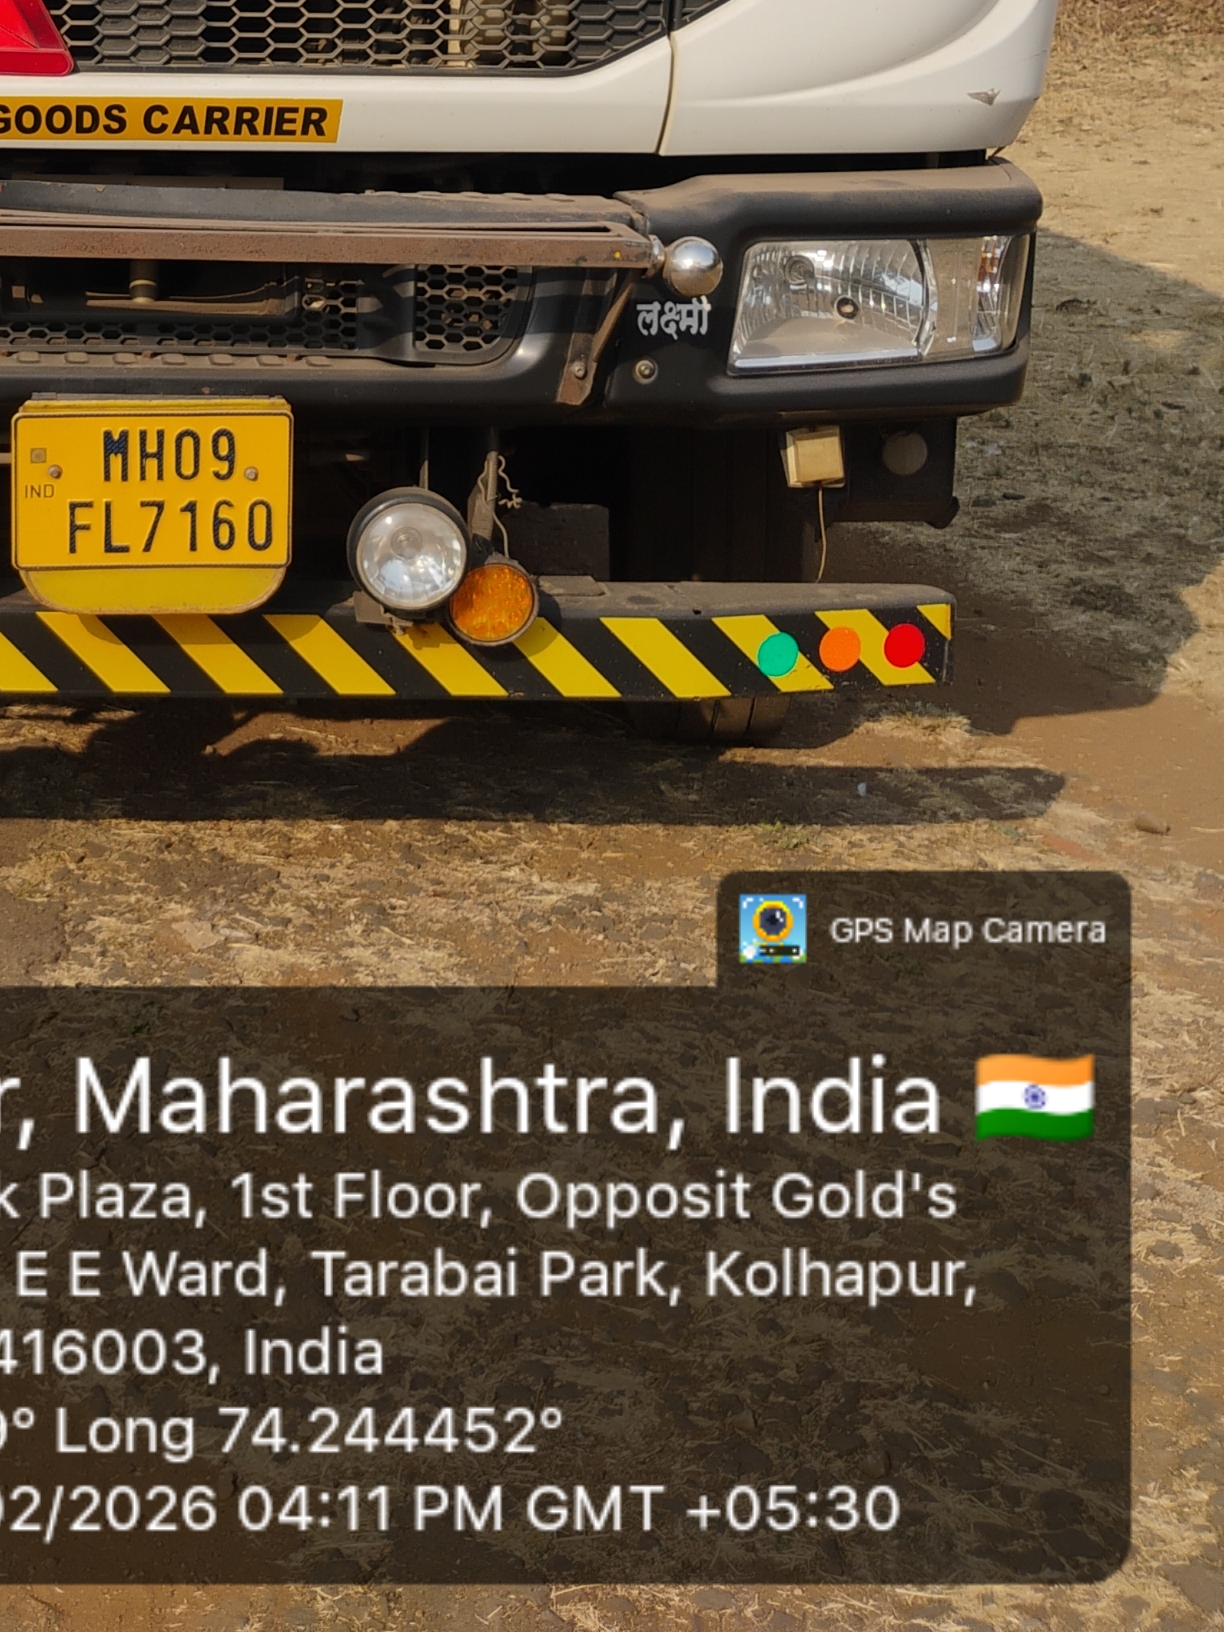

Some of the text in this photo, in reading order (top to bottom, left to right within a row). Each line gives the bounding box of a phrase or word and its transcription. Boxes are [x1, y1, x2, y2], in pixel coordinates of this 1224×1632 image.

[142, 104, 329, 137] CARRIER
[102, 427, 236, 482] MH09
[24, 484, 55, 499] IND
[68, 498, 273, 554] FL7160
